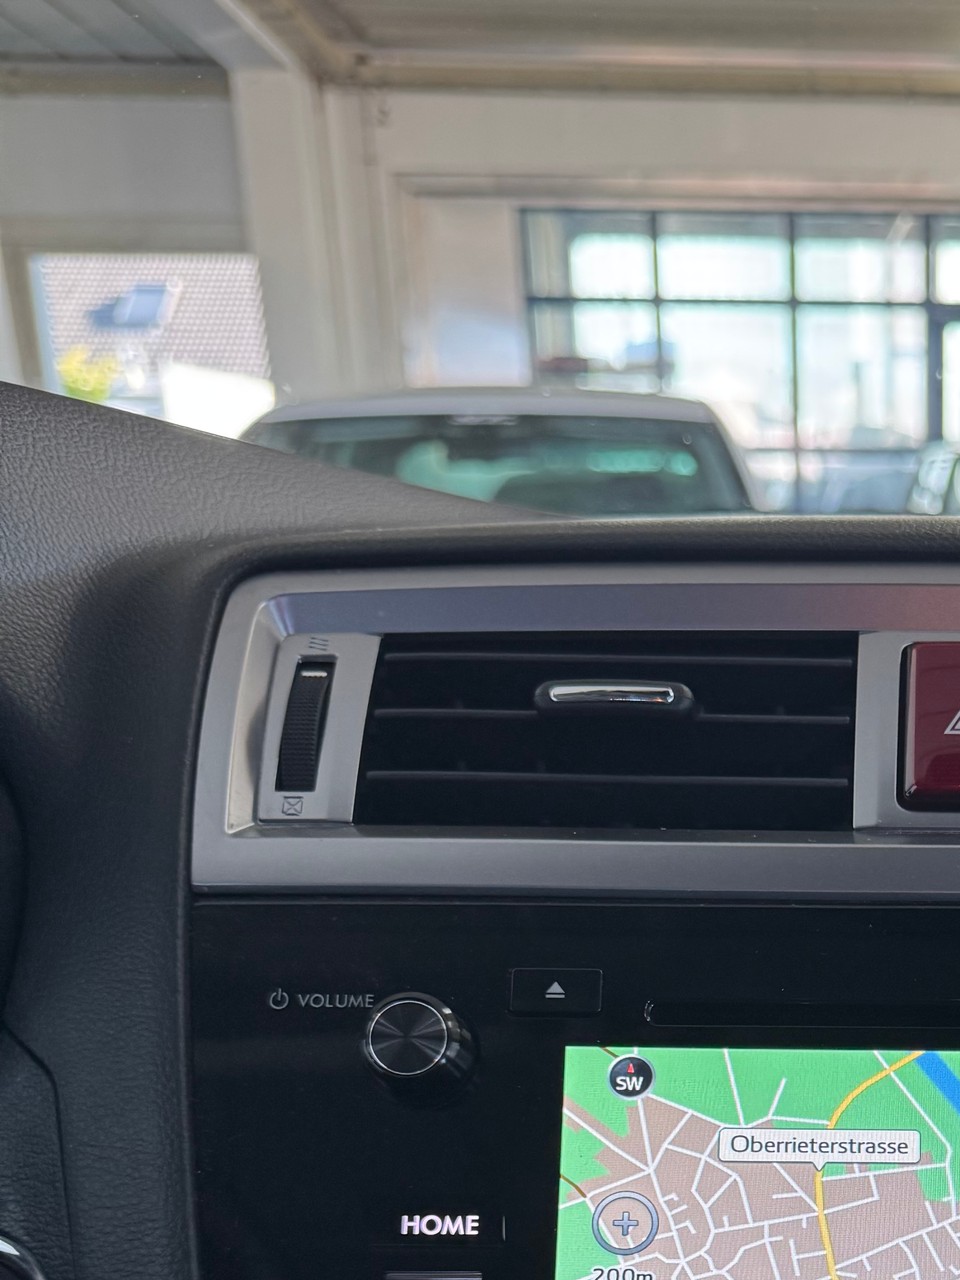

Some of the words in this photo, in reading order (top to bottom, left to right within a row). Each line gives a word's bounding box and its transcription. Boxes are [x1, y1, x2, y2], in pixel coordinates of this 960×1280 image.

[299, 994, 374, 1008] VOLUME
[615, 1076, 643, 1091] SW
[731, 1135, 908, 1155] Oberrieterstrasse
[400, 1215, 480, 1235] HOME
